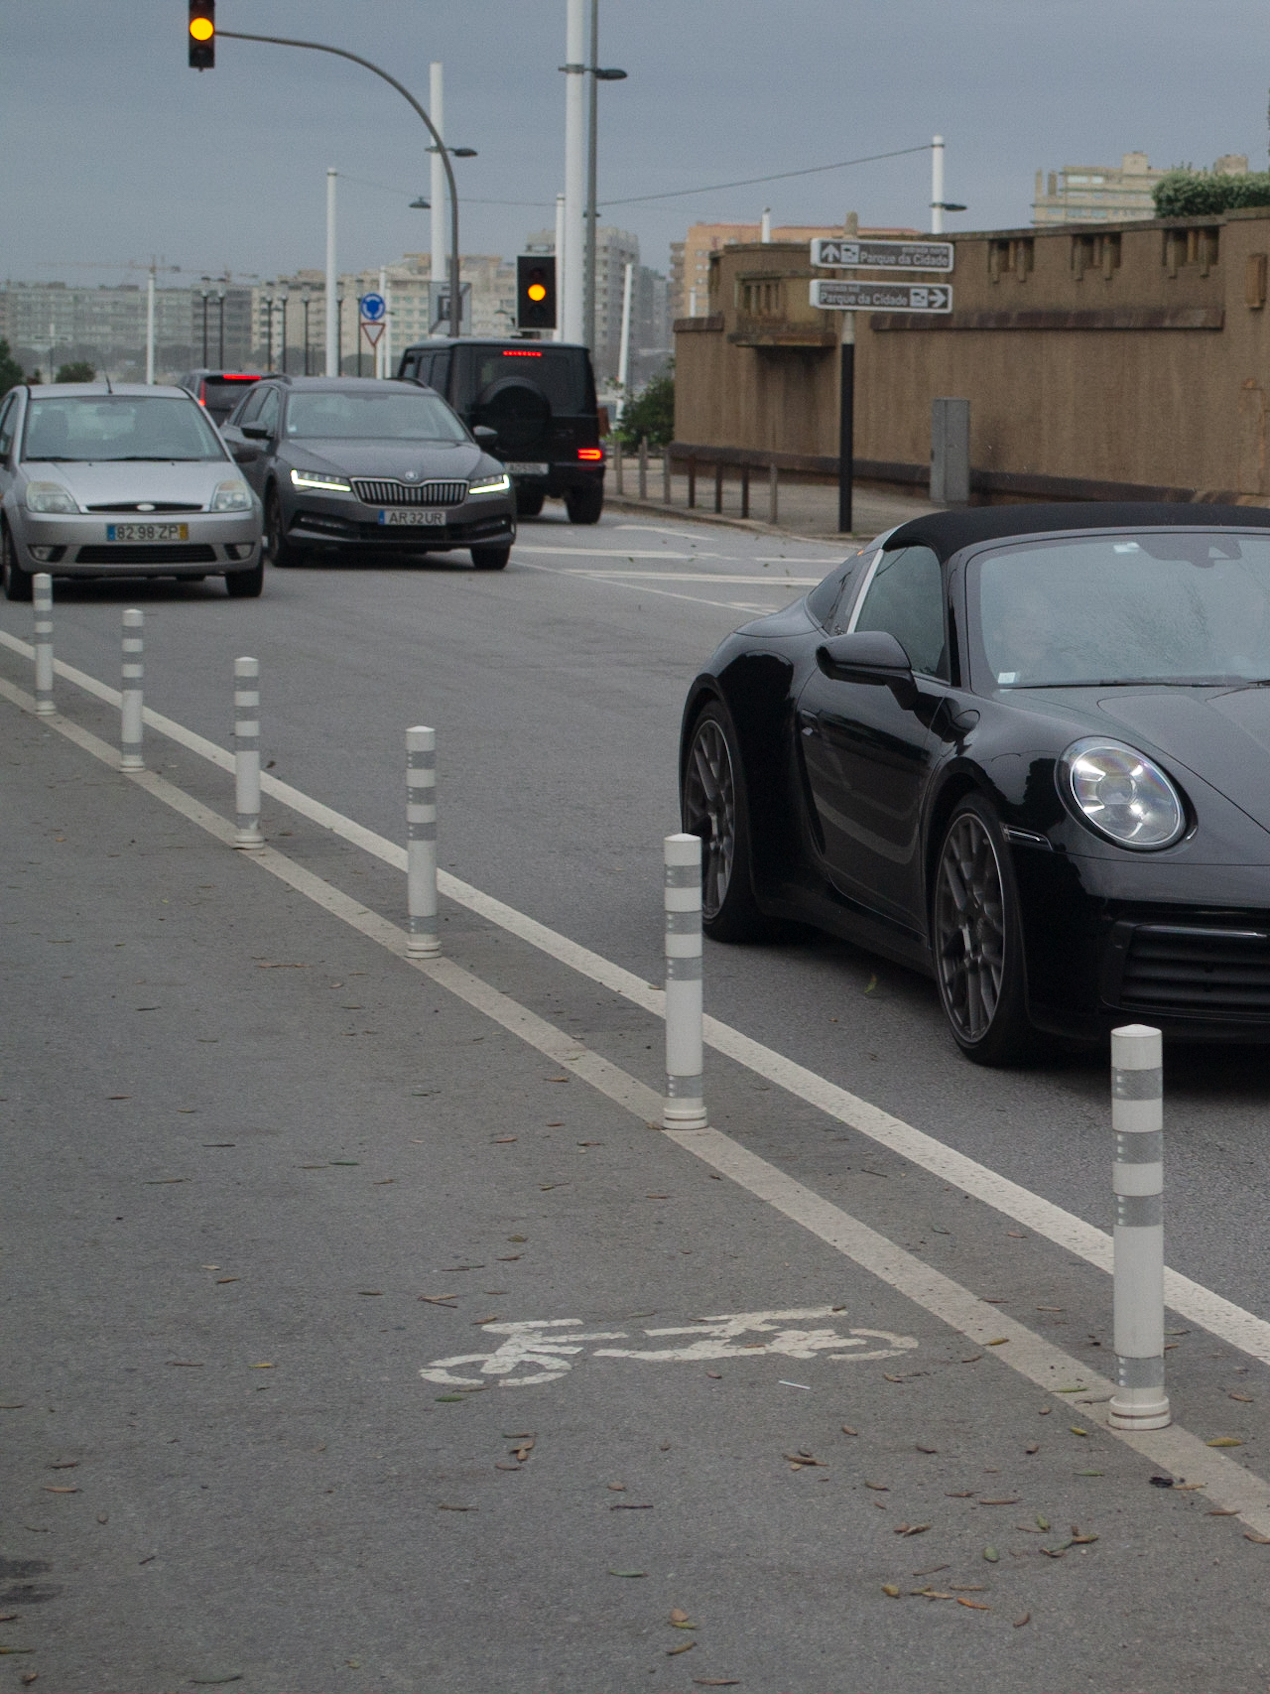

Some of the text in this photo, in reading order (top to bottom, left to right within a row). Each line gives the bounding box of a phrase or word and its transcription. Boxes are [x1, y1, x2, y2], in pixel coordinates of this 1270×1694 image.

[860, 252, 949, 266] Parque da Cidade
[820, 292, 908, 306] Parque da Cidade
